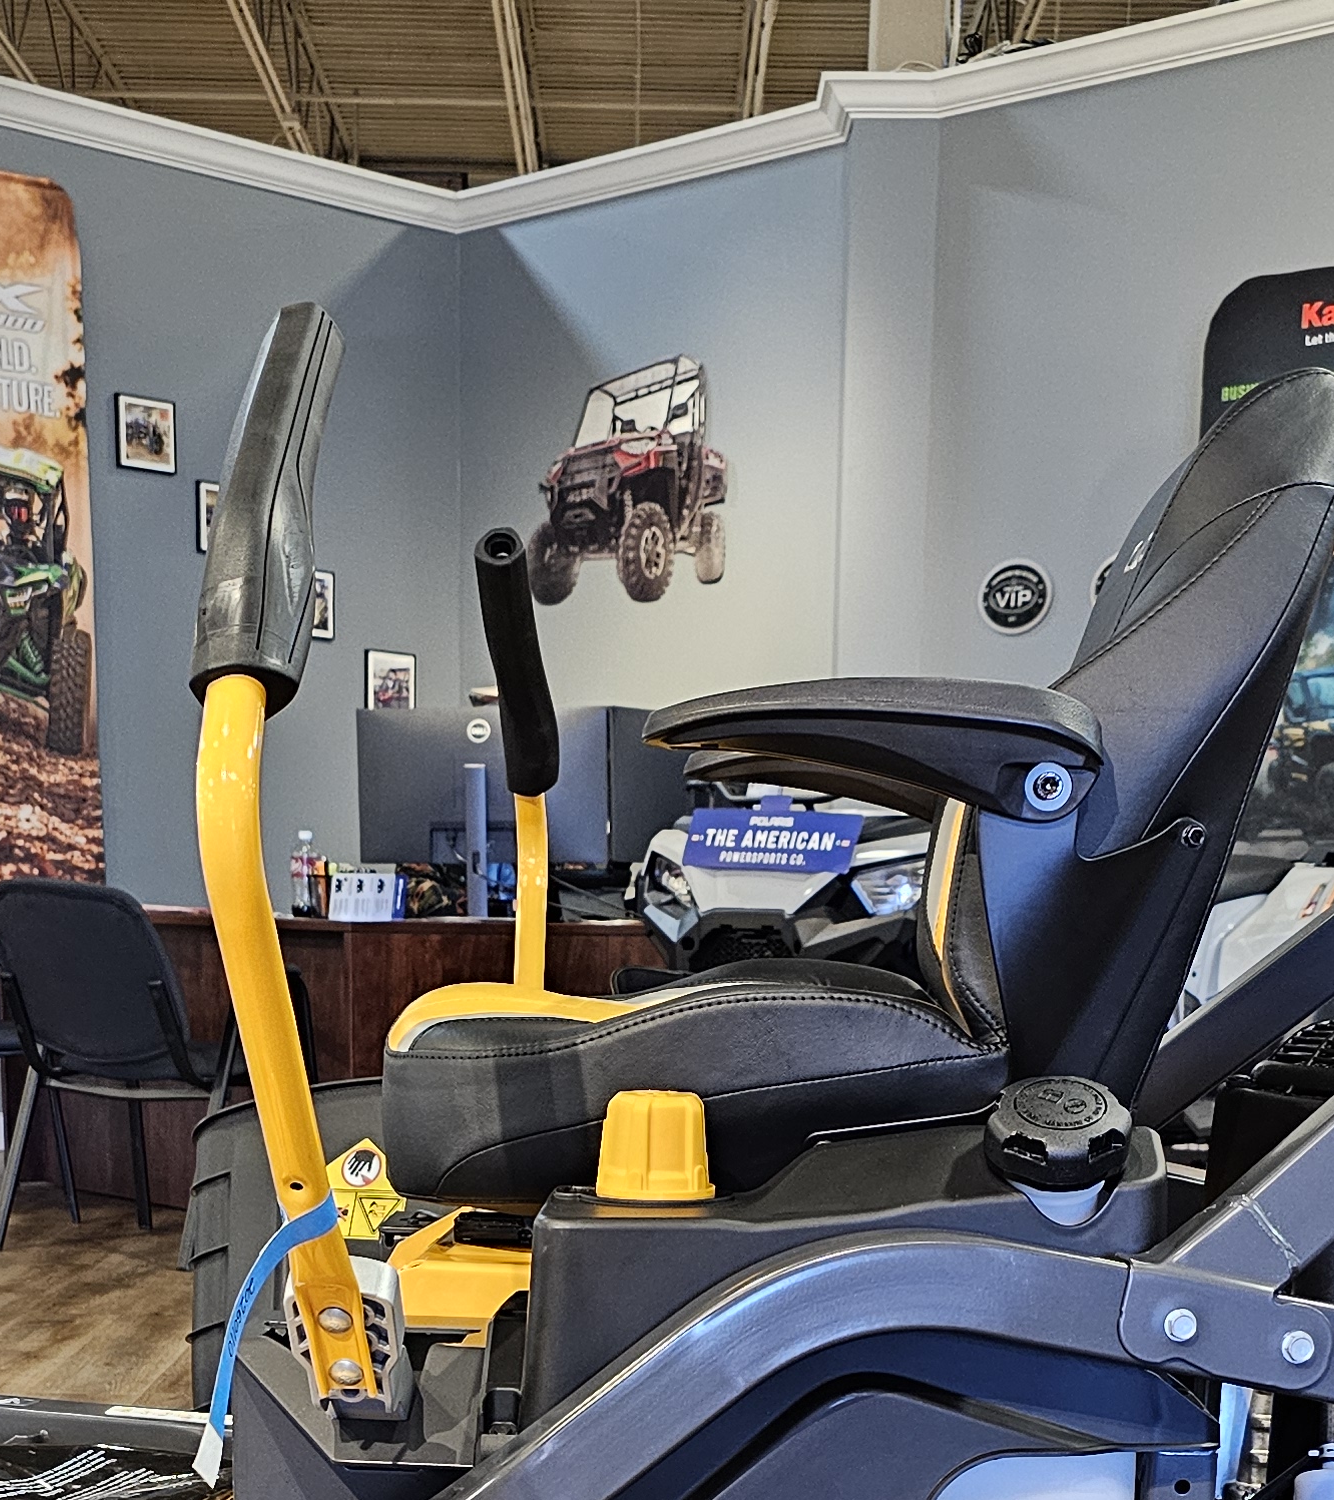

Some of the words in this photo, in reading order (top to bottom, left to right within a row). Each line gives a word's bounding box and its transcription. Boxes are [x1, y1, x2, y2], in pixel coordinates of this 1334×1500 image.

[1305, 334, 1323, 347] Let
[995, 588, 1032, 608] VIP
[705, 828, 738, 847] THE
[740, 829, 837, 852] AMERICAN
[719, 850, 788, 865] POWERSPORTS
[789, 853, 806, 867] CO.
